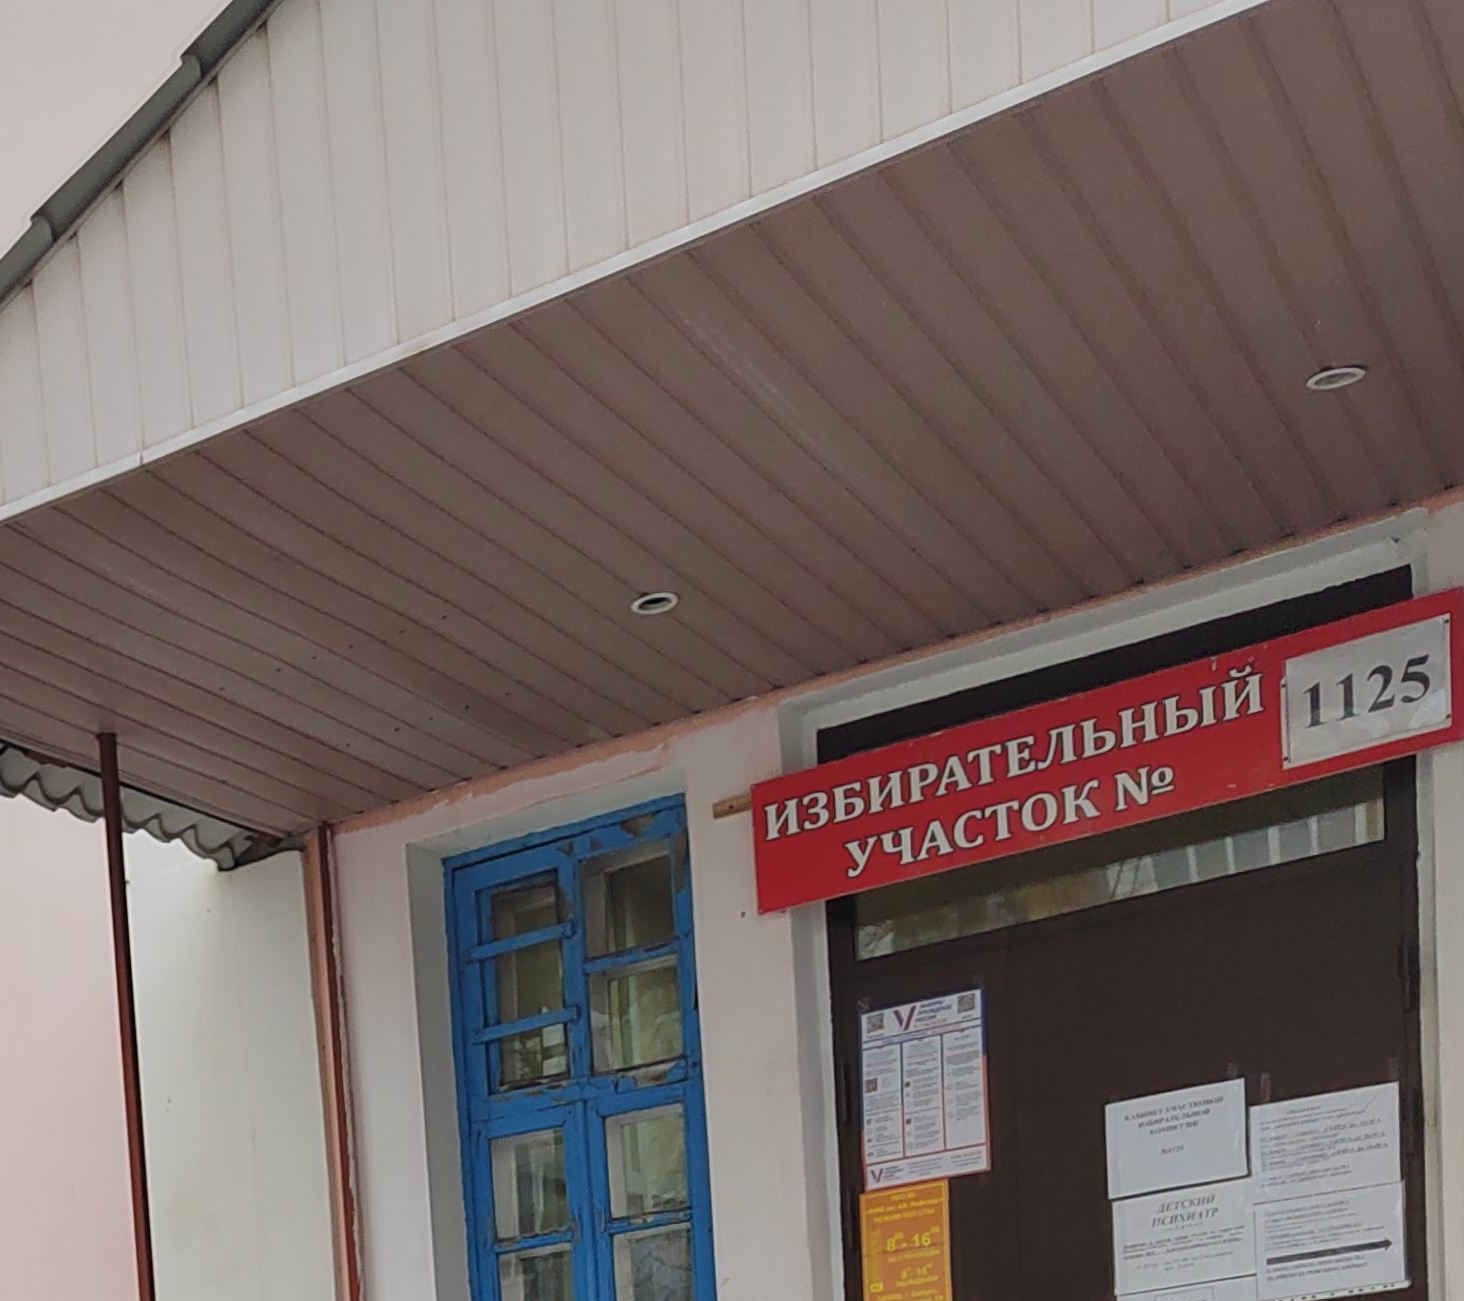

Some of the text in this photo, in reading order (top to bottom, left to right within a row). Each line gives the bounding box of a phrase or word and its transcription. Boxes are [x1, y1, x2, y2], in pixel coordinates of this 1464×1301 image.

[1299, 654, 1432, 729] 1125
[764, 667, 1264, 841] ИЗБИРАТЕЛЬНЫЙ
[845, 765, 1176, 878] УЧАСТОК №
[1152, 1207, 1219, 1228] ПСИХИАТР
[1156, 1193, 1216, 1214] ДЕТСКИЙ
